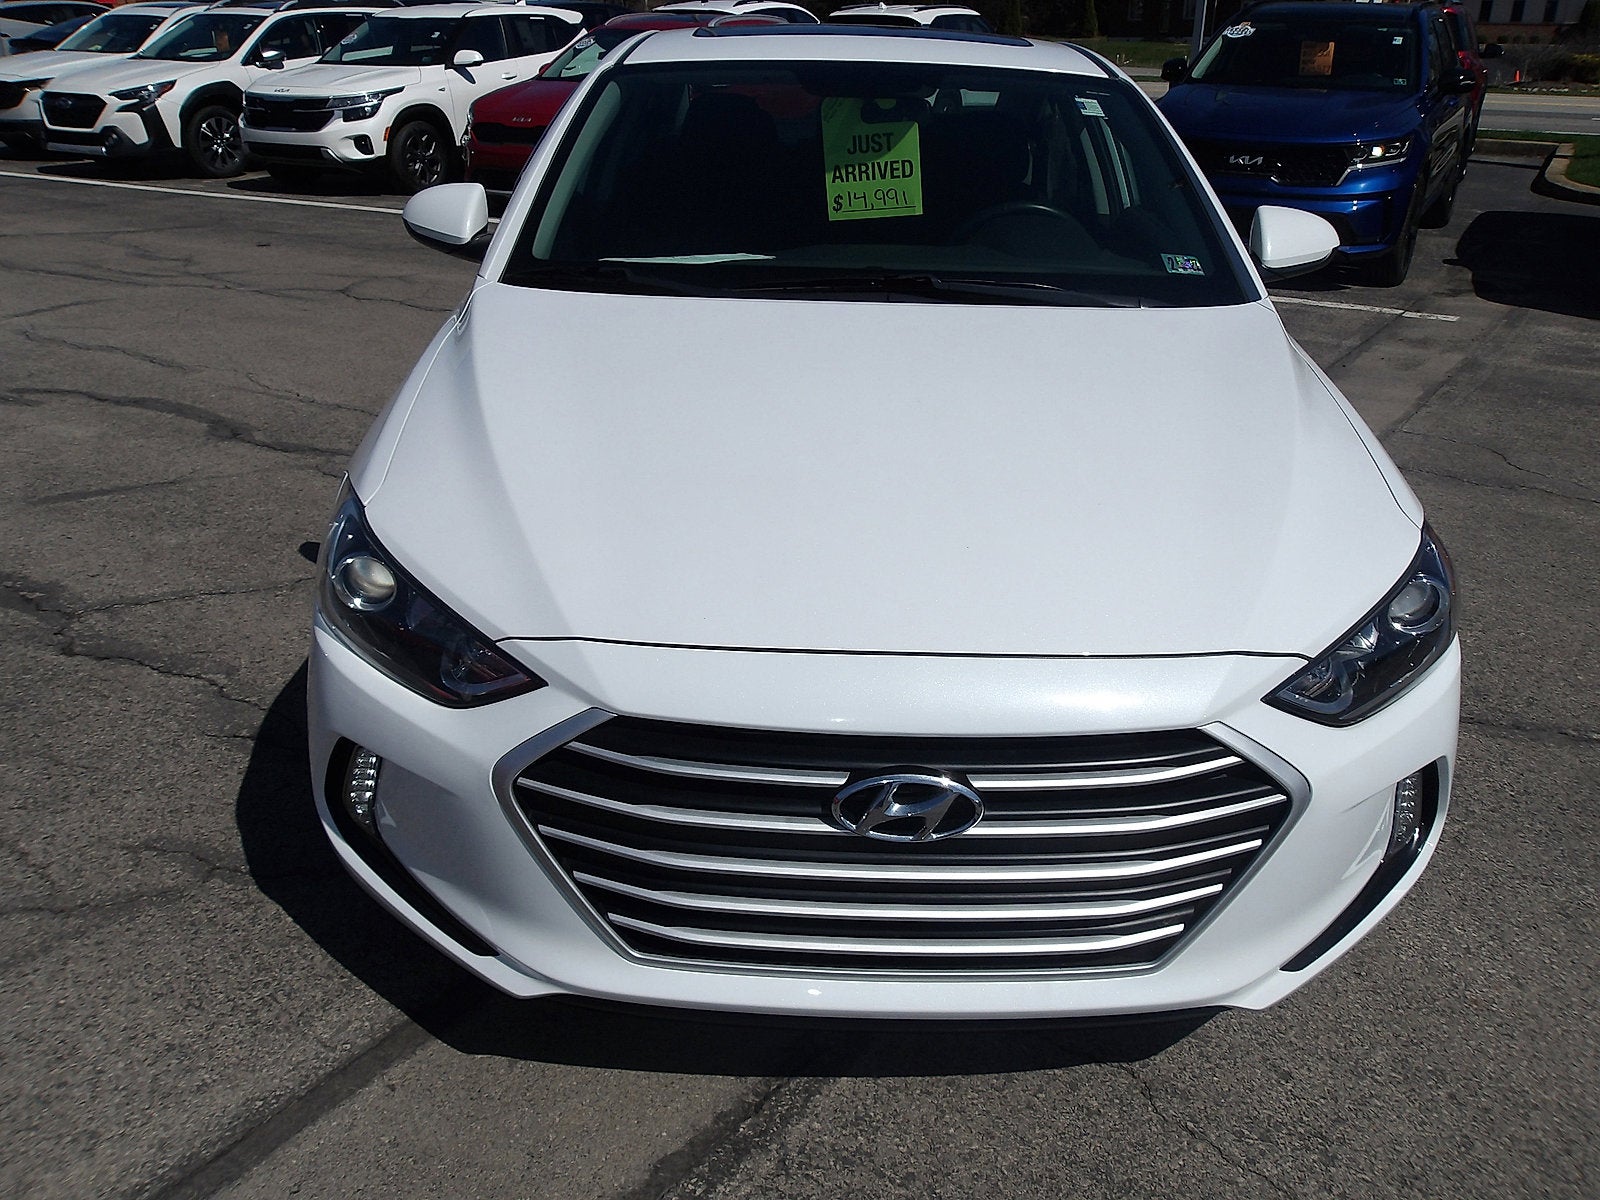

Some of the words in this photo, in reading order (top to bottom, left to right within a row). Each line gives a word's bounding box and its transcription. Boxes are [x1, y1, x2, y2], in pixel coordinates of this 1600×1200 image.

[847, 132, 894, 155] JUST
[831, 159, 914, 184] ARRIVED
[1229, 155, 1264, 165] KIA
[832, 188, 909, 213] $14,991
